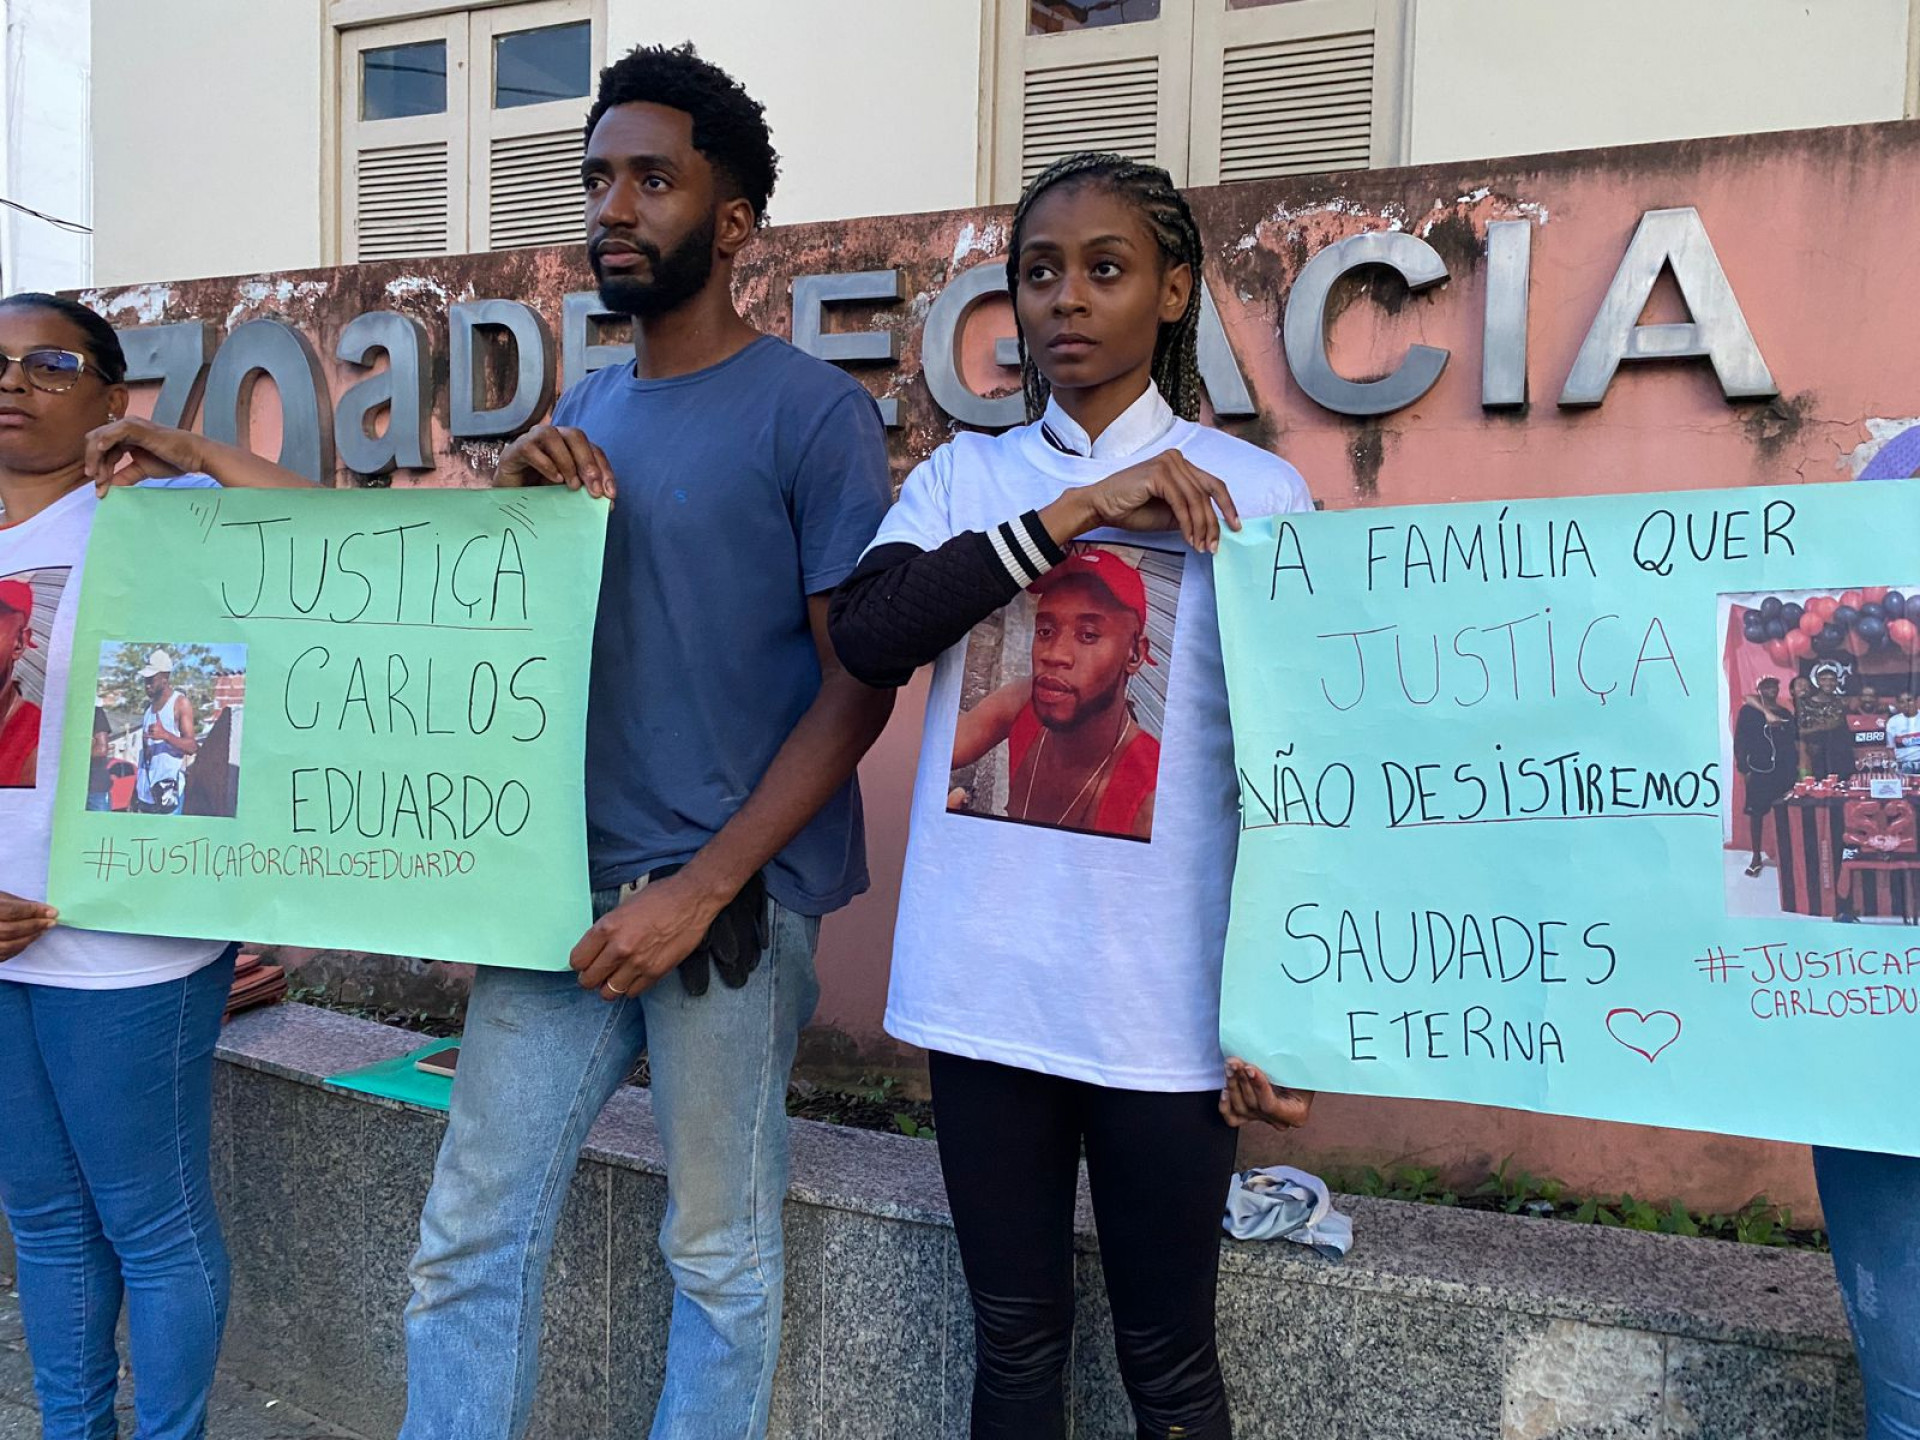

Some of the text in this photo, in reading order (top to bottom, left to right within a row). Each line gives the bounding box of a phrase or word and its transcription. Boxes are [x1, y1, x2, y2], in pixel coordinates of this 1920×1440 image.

[1270, 500, 1796, 600] A FAMÍLIA QUER
[285, 646, 548, 741] CARLOS
[292, 767, 530, 840] EDUARDO
[1240, 743, 1355, 827] NÃO
[1281, 902, 1616, 985] SAUDADES
[1346, 1006, 1565, 1064] ETERNA
